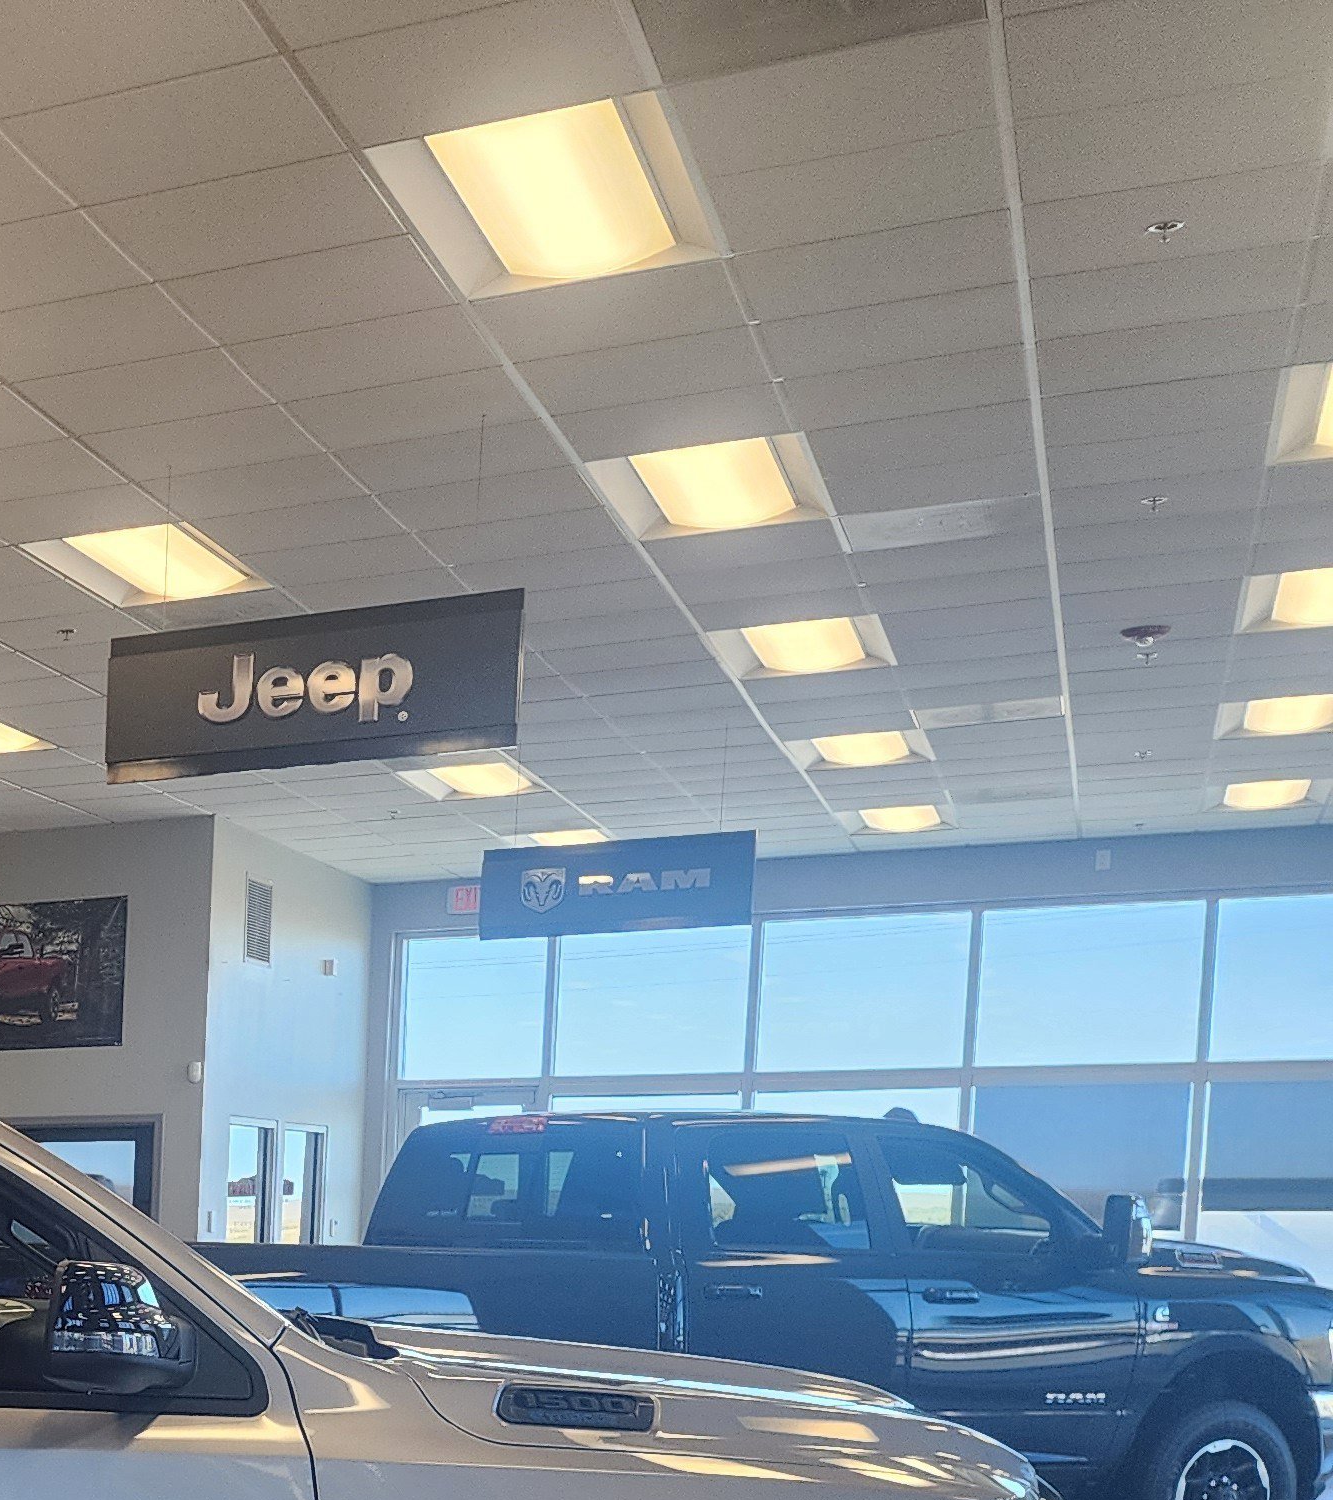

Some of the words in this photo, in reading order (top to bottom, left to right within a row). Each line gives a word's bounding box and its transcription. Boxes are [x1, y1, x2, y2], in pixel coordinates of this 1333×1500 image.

[578, 867, 711, 897] RAM
[454, 886, 480, 911] EXI
[510, 1391, 636, 1414] 1500
[1045, 1392, 1106, 1404] RAM
